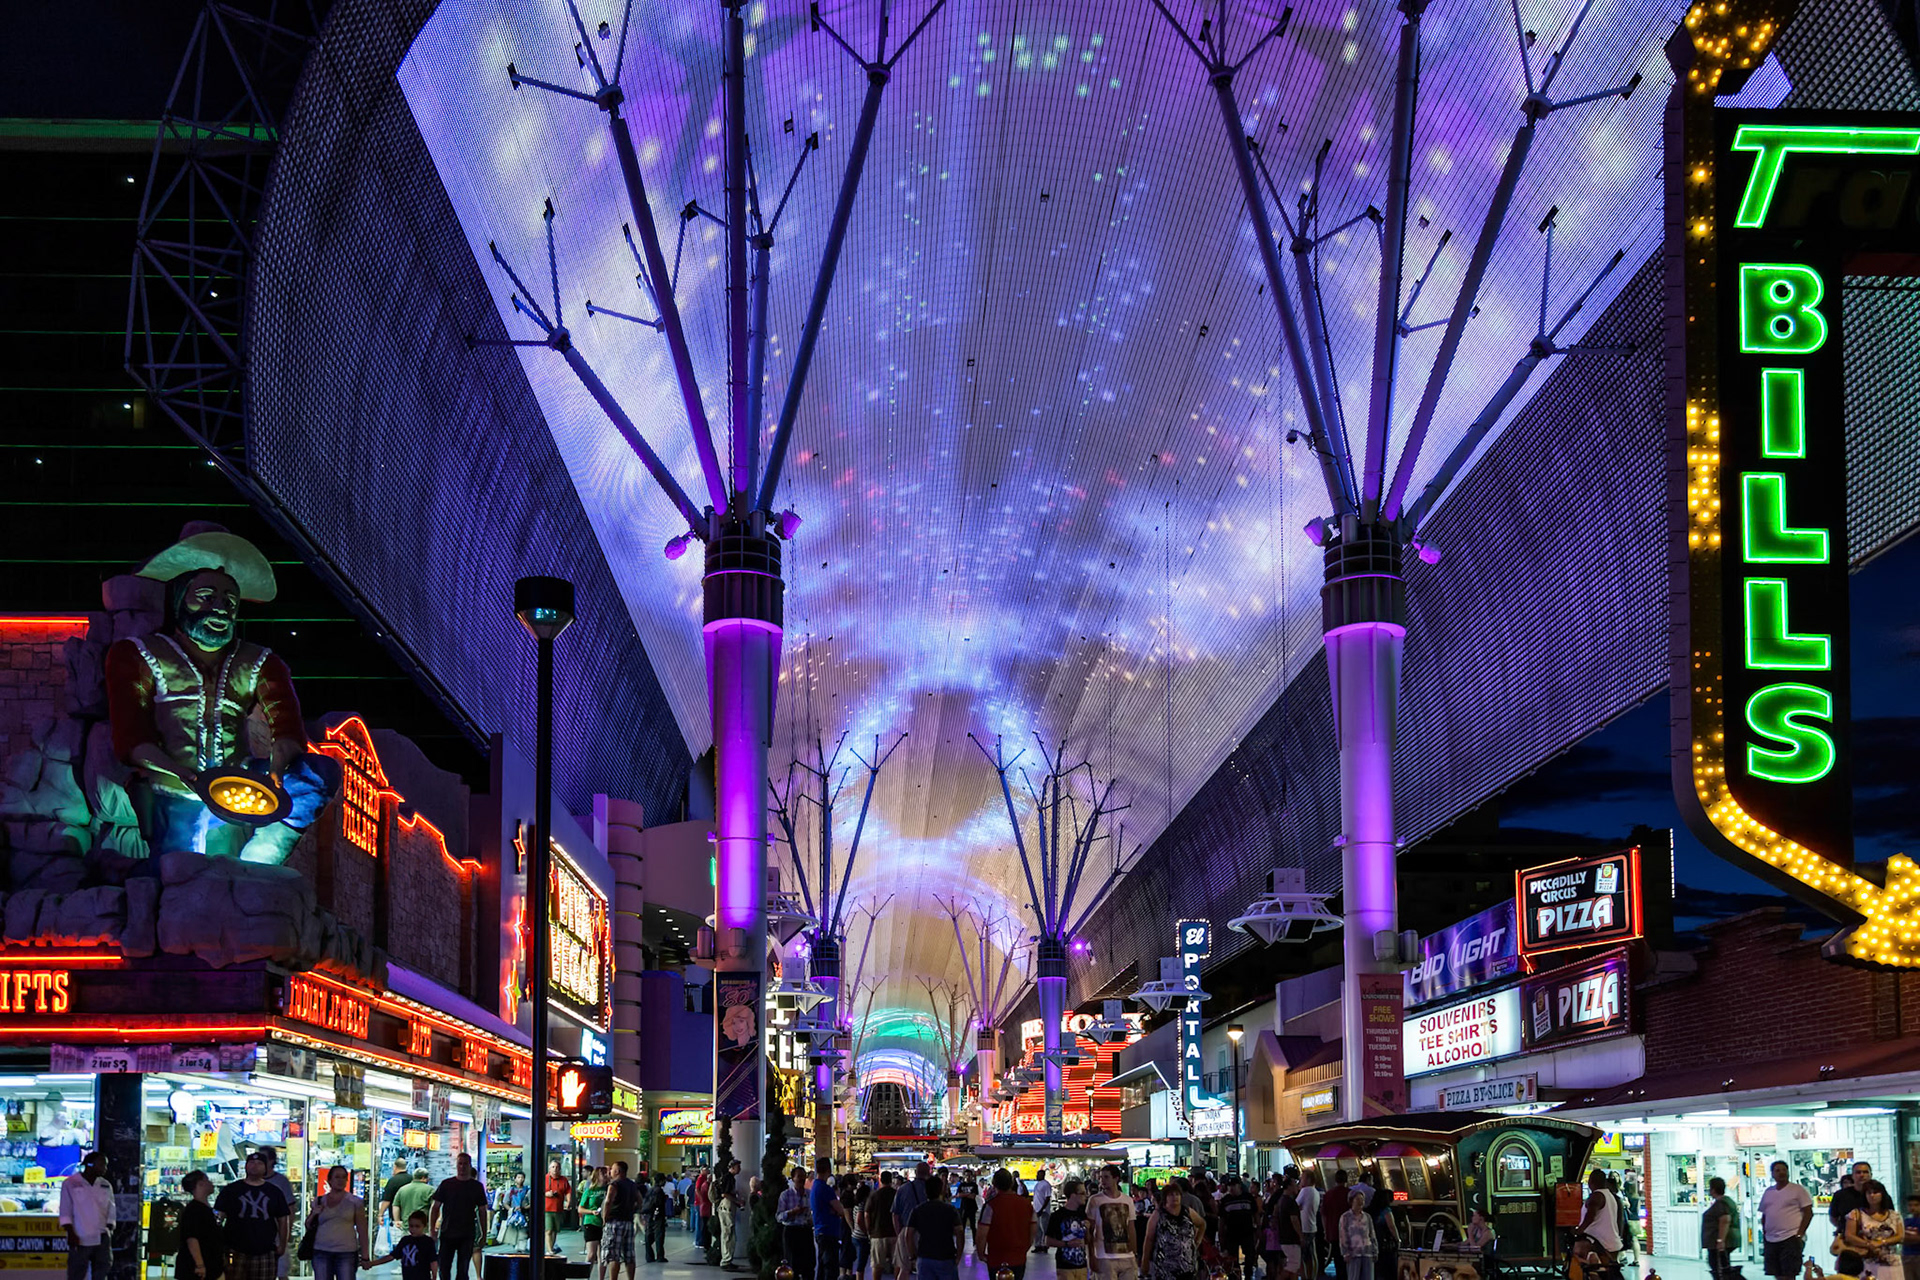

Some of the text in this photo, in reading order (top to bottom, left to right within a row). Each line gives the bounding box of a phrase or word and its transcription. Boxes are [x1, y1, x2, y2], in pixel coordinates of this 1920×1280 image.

[1739, 262, 1836, 784] BILLS
[1530, 871, 1587, 894] PICCADILLY
[1541, 887, 1577, 903] CIRCUS
[1537, 896, 1613, 937] PIZZA
[1186, 927, 1205, 945] El
[550, 922, 599, 1005] VEGAS
[1410, 953, 1446, 985] BUD
[1454, 927, 1506, 969] LIGHT
[1373, 1006, 1391, 1014] FREE
[1558, 971, 1619, 1027] PIZZA
[1184, 953, 1200, 1080] PORTAL
[1369, 1014, 1395, 1022] SHOWS
[1419, 998, 1496, 1035] SOUVENIRS
[1419, 1019, 1498, 1051] TEE SHIRTS
[1427, 1041, 1491, 1067] ALCOHOL
[1447, 1089, 1471, 1106] PIZZA
[1204, 1111, 1221, 1120] INDIAN
[1477, 1122, 1497, 1131] PAST
[1500, 1117, 1536, 1126] PRESENT
[575, 1126, 613, 1135] LIQUOR
[1792, 1122, 1817, 1139] 324
[238, 1190, 270, 1221] NY
[0, 1238, 15, 1251] AND
[17, 1238, 45, 1251] CANYON
